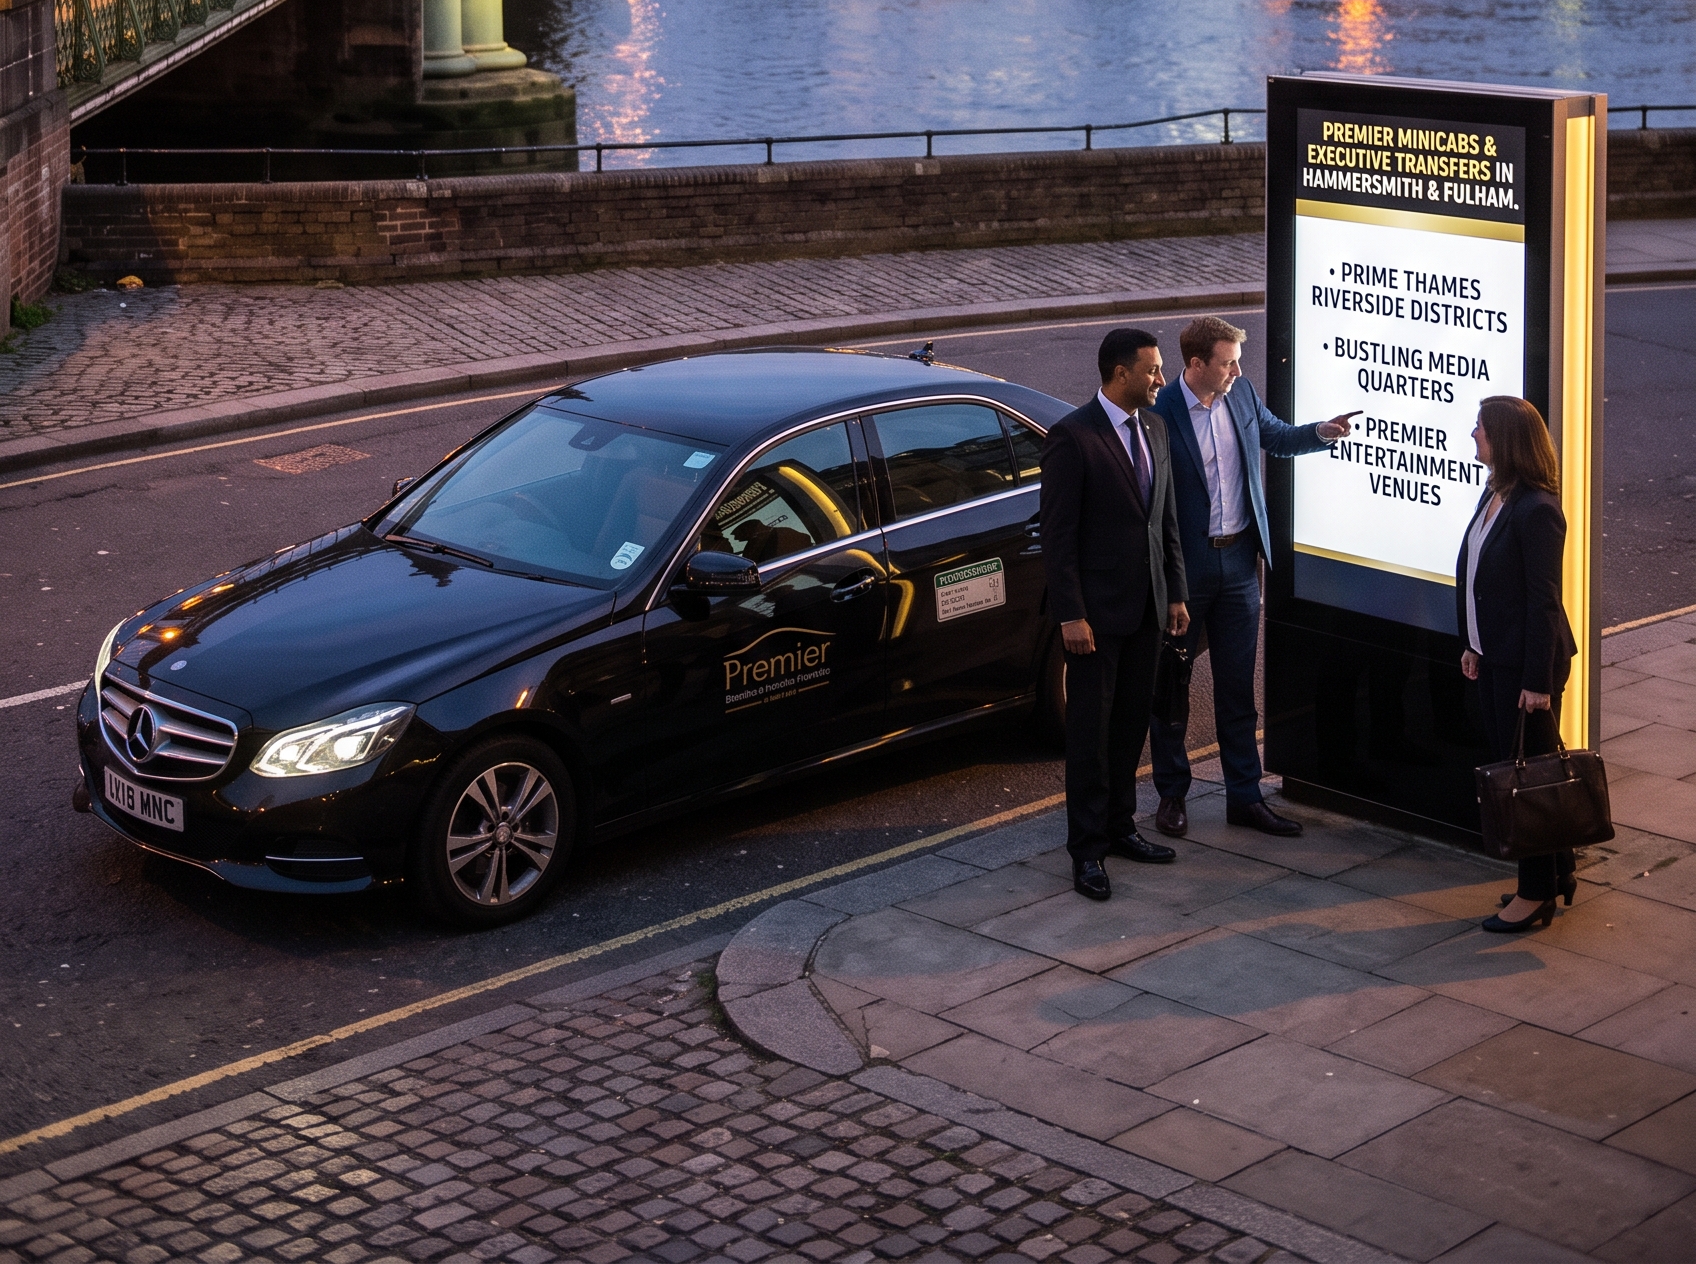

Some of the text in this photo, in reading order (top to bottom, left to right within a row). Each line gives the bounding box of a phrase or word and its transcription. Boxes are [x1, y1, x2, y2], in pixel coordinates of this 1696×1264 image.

[1323, 121, 1497, 157] PREMIER MINICABS &
[1307, 144, 1514, 184] EXECUTIVE TRANSFERS IN
[1303, 167, 1519, 210] HAMMERSMITH & FULHAM.
[1342, 262, 1481, 301] PRIME THAMES
[1312, 285, 1508, 334] RIVERSIDE DISTRICTS
[1335, 336, 1490, 381] BUSTLING MEDIA
[1358, 368, 1454, 404] QUARTERS
[1366, 416, 1447, 451] PREMIER
[1369, 472, 1442, 506] VENUES
[723, 641, 831, 690] Premier
[140, 790, 175, 824] MNC
